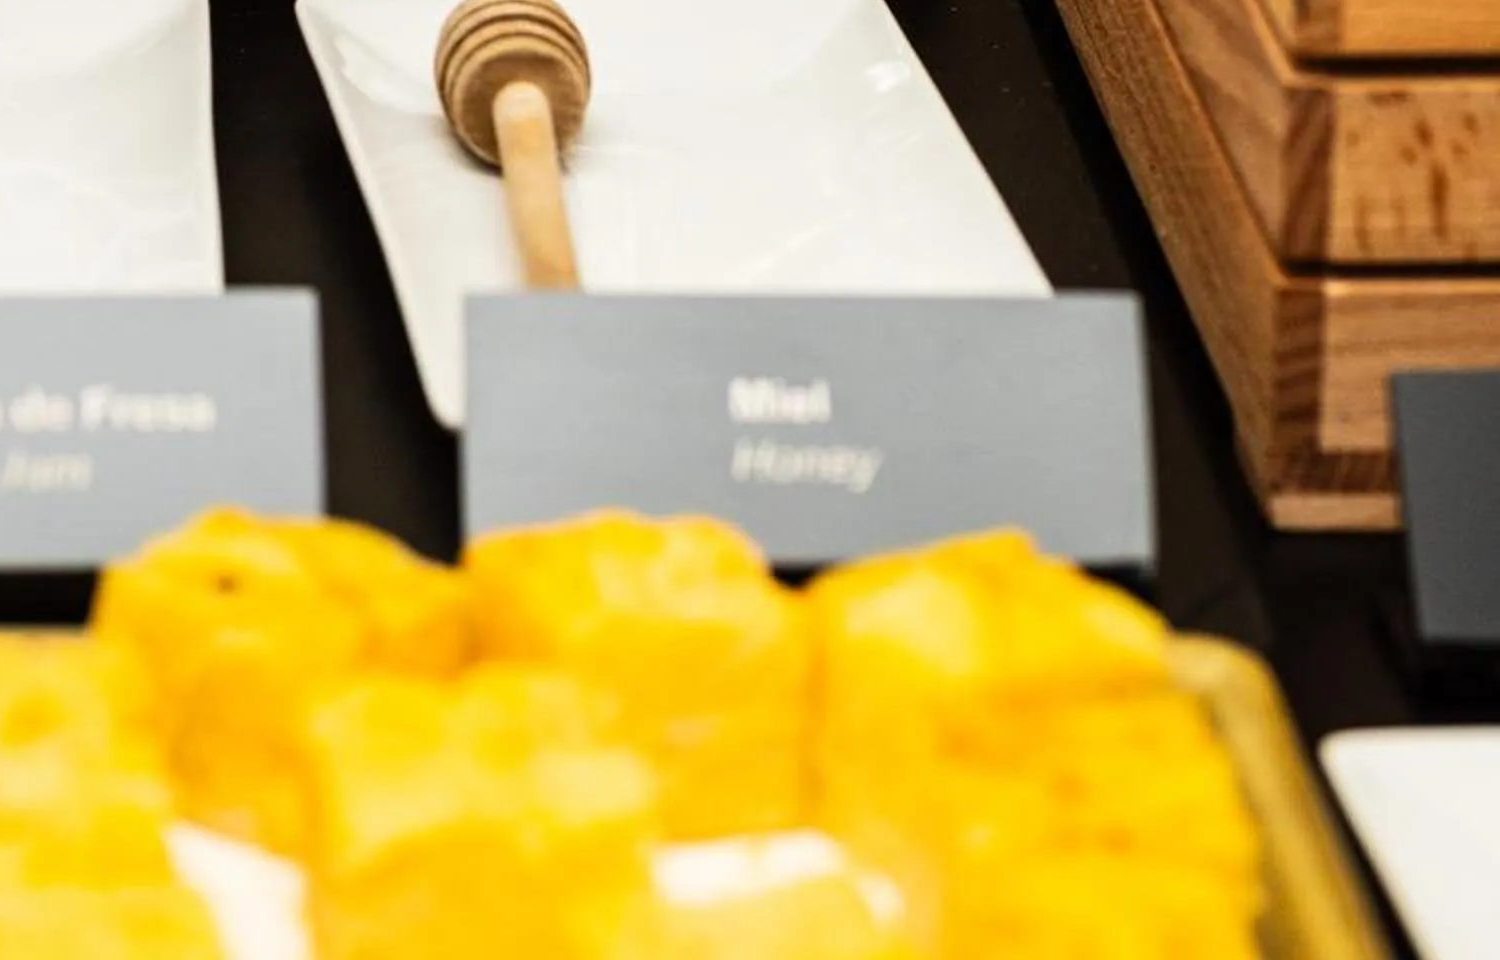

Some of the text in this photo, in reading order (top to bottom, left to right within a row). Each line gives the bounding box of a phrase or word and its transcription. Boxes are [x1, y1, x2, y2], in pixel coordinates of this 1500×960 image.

[10, 386, 73, 431] de
[80, 385, 215, 431] Fresa
[728, 376, 831, 424] Miel
[731, 439, 883, 494] Honey
